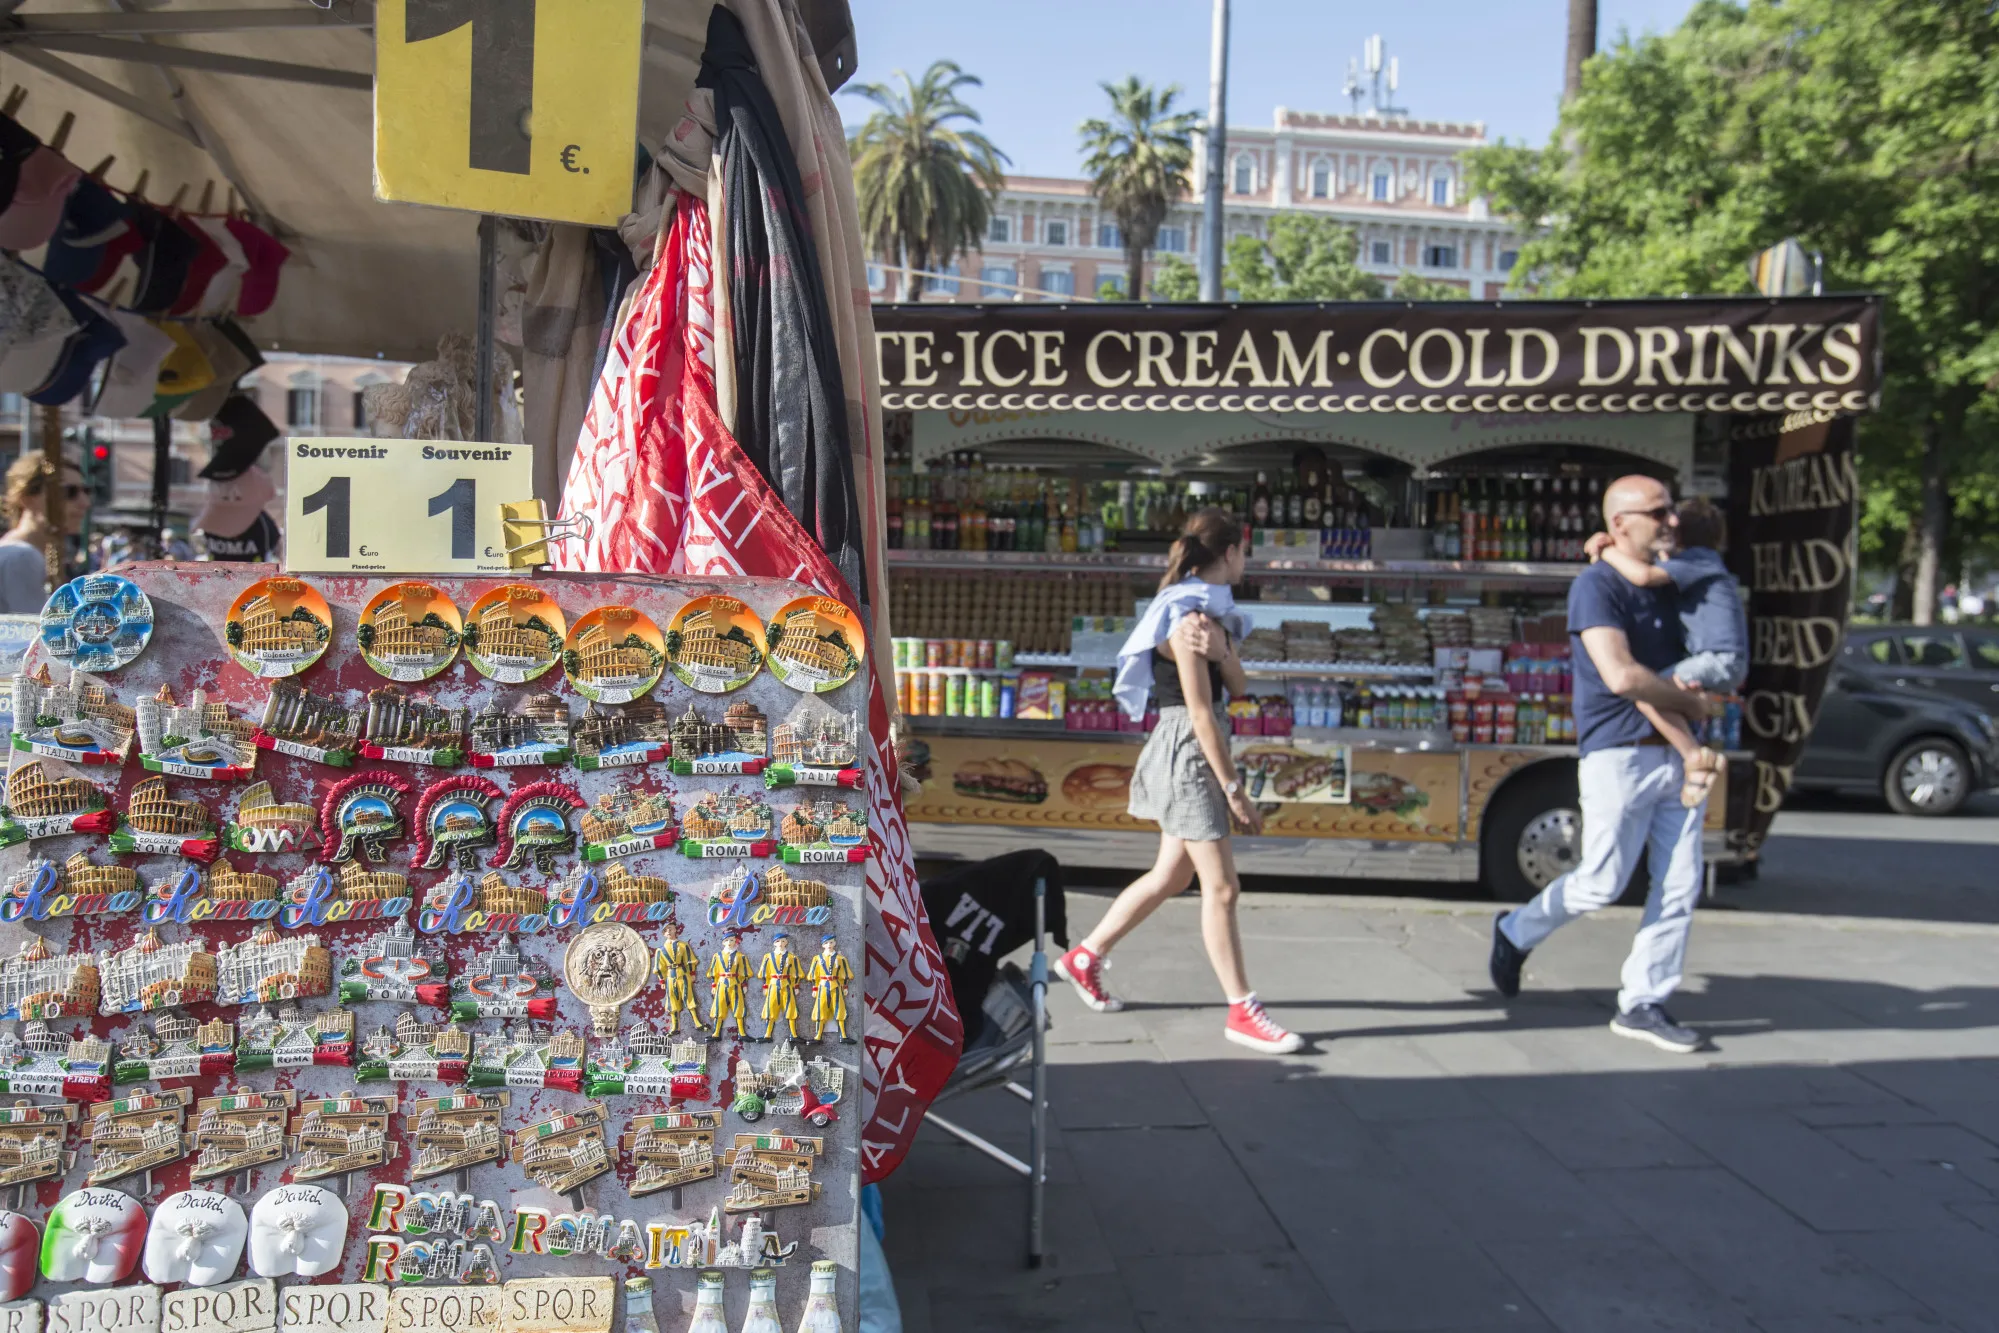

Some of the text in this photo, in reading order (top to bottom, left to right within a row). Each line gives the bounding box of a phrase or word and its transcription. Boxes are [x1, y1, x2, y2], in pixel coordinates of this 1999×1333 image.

[405, 0, 536, 175] 1
[1579, 323, 1862, 386] DRINKS
[296, 443, 388, 459] Souvenir
[422, 446, 512, 461] Souvenir
[303, 476, 350, 558] 1
[428, 479, 476, 559] 1
[814, 597, 849, 618] ROMA
[262, 651, 295, 659] Colosseo
[40, 745, 77, 761] ITALIA
[277, 740, 321, 761] ROMA
[386, 752, 431, 763] ROMA
[497, 754, 541, 766] ROMA
[602, 753, 645, 767] ROMA
[169, 763, 206, 777] ITALIA
[696, 763, 739, 773] ROMA
[795, 770, 838, 782] ITALIA
[354, 826, 382, 834] ROMA
[445, 832, 474, 840] ROMA
[608, 839, 651, 856] ROMA
[706, 845, 748, 856] ROMA
[803, 851, 845, 862] ROMA
[0, 860, 136, 923] Roma
[143, 864, 277, 923] Roma
[280, 866, 408, 928] Roma
[549, 868, 673, 928] Roma
[419, 876, 545, 934] Roma
[708, 870, 830, 927] Roma
[366, 989, 418, 1000] ROMA
[478, 1006, 529, 1016] ROMA
[277, 1055, 308, 1064] ROMA
[155, 1065, 195, 1075] ROMA
[393, 1070, 432, 1078] ROMA
[21, 1074, 64, 1082] COLOSSEO
[509, 1077, 539, 1085] ROMA
[593, 1074, 629, 1082] VATICANO
[14, 1084, 57, 1094] ROMA
[627, 1084, 667, 1094] ROMA
[132, 1114, 160, 1122] COLOSSEO
[557, 1132, 583, 1143] COLOSSEO
[74, 1190, 126, 1211] David
[176, 1193, 224, 1214] David
[274, 1189, 323, 1206] David
